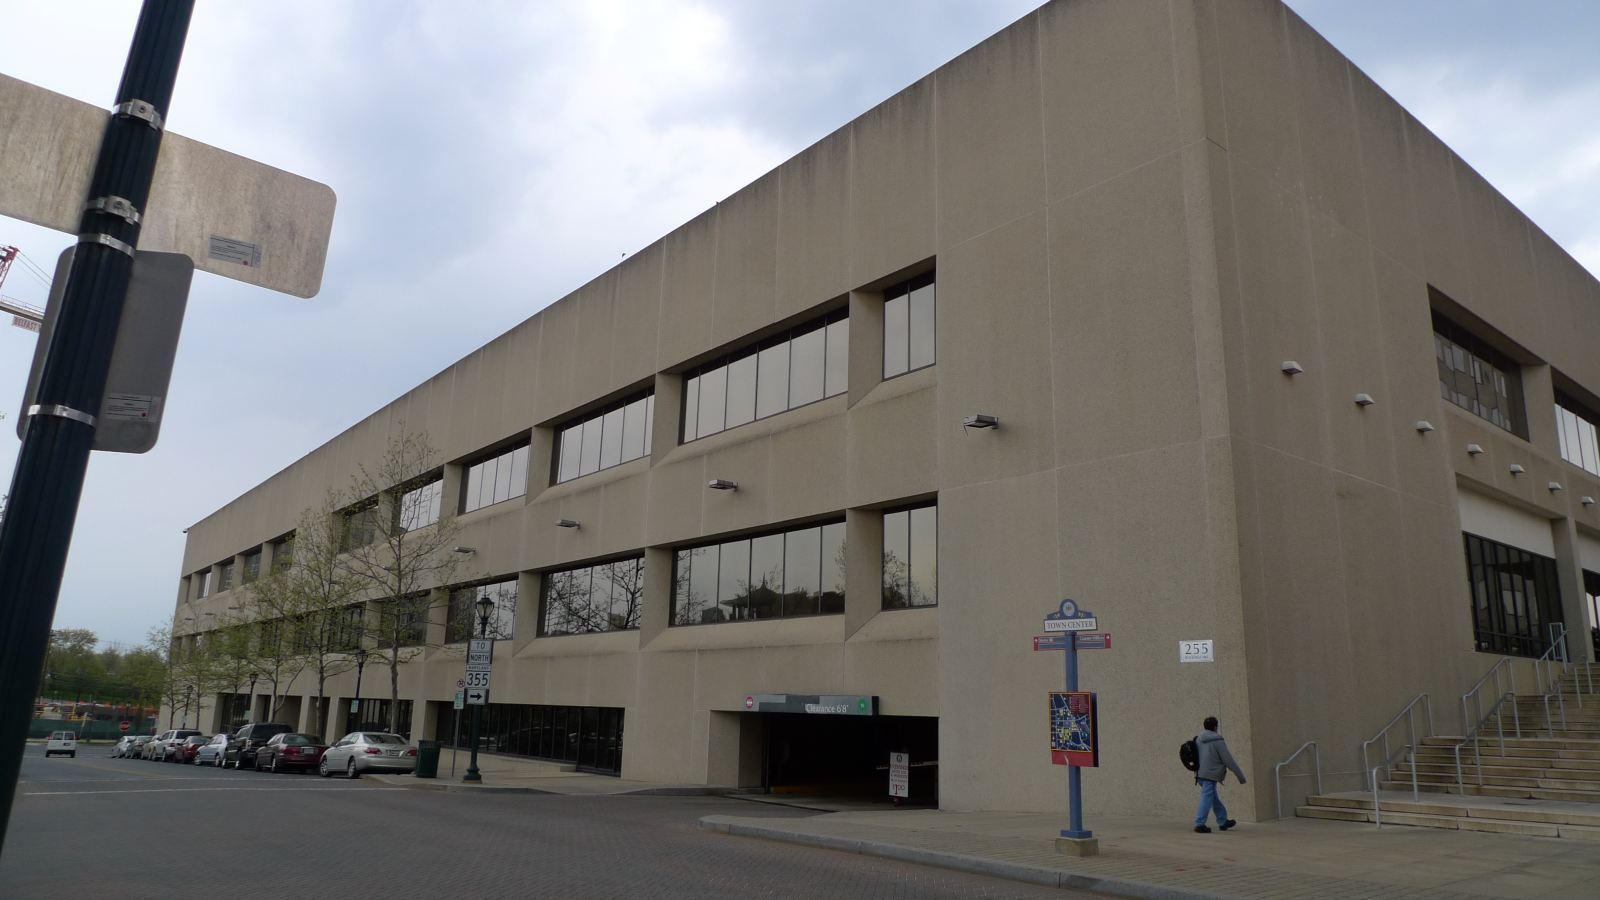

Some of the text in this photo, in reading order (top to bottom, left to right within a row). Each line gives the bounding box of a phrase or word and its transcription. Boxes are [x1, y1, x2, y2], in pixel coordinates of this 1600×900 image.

[1046, 620, 1093, 629] TOWN CENTER
[1185, 643, 1209, 655] 255
[467, 673, 489, 687] 355
[804, 703, 836, 713] Clearance
